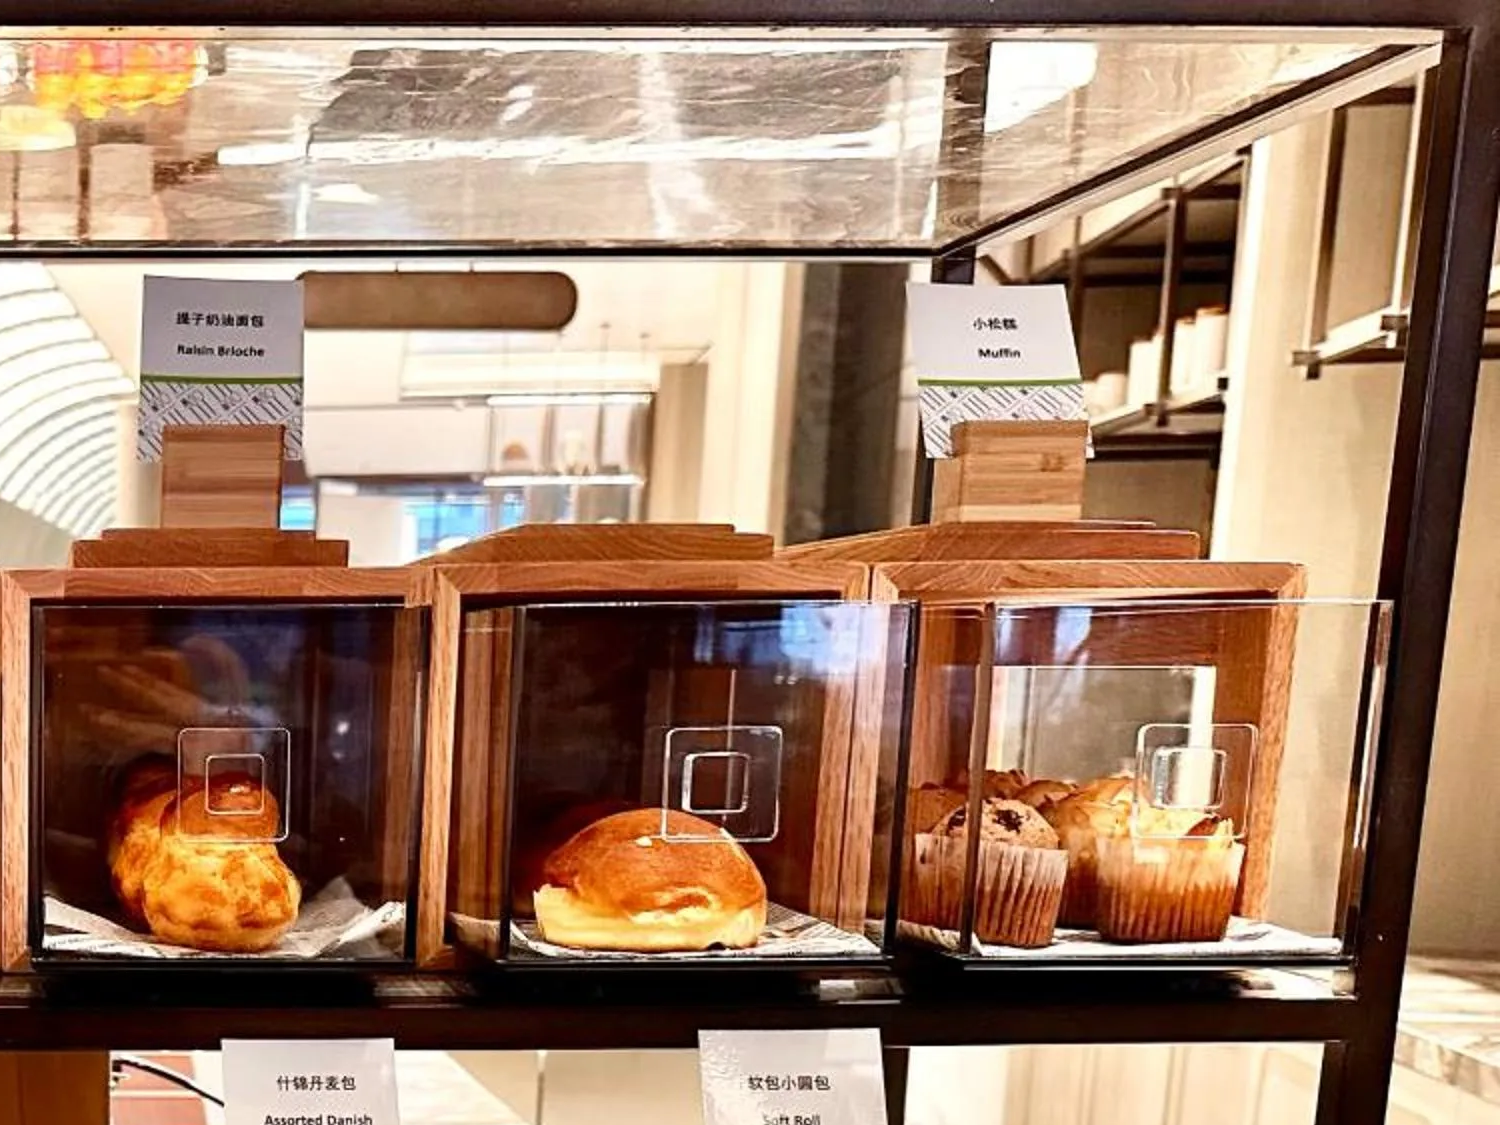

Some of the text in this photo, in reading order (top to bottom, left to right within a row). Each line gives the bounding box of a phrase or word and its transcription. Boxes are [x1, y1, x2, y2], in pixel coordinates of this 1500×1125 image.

[973, 316, 1019, 331] 小松糕
[177, 343, 265, 357] Raisin Brioche
[977, 347, 1021, 359] Muffin
[276, 1074, 357, 1092] 什锦丹麦包
